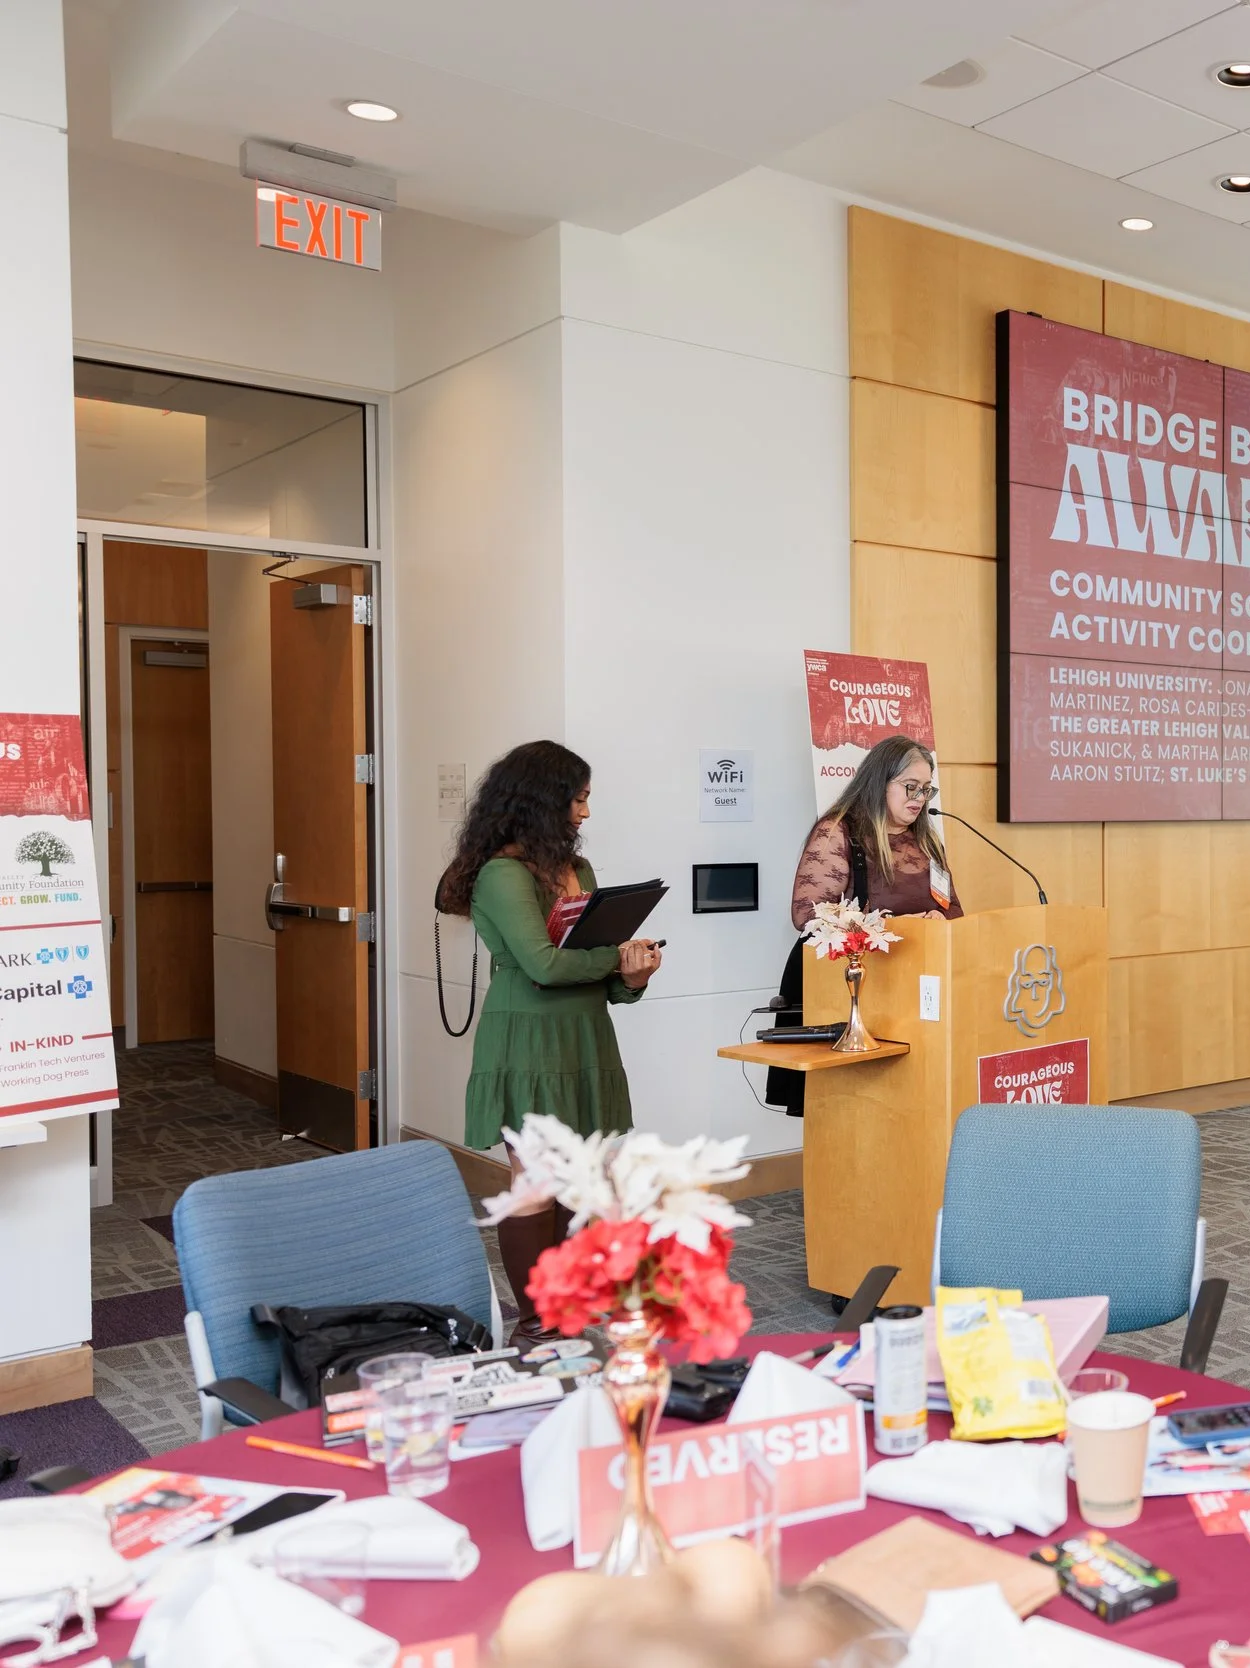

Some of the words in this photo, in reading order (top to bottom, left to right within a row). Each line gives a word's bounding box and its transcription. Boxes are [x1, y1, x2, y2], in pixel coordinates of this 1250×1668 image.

[275, 192, 370, 265] EXIT
[1063, 386, 1217, 459] BRIDGE
[1049, 570, 1222, 614] COMMUNITY
[1049, 611, 1180, 650] ACTIVITY
[829, 679, 911, 698] COURAGEOUS
[1050, 667, 1110, 687] LEHIGH
[1116, 672, 1213, 694] UNIVERSITY:
[844, 696, 901, 727] LOVE
[1050, 692, 1134, 714] MARTINEZ,
[1139, 698, 1180, 714] ROSA
[1050, 716, 1082, 733] THE
[1087, 717, 1160, 736] GREATER
[1164, 721, 1218, 738] LEHIGH
[1050, 740, 1136, 761] SUKANICK,
[1141, 744, 1152, 759] &
[1158, 744, 1218, 760] MARTHA
[708, 770, 743, 783] WiFi
[1050, 765, 1108, 781] AARON
[1114, 765, 1164, 784] STUTZ;
[1170, 767, 1193, 782] ST.
[1198, 767, 1247, 783] LUKE'S
[714, 797, 737, 805] Guest
[29, 877, 84, 889] Foundation
[20, 894, 51, 905] GROW.
[55, 892, 82, 903] FUND.
[10, 1034, 74, 1053] IN-KIND
[40, 1057, 62, 1067] Tech
[64, 1052, 105, 1063] Ventures
[1, 1075, 41, 1088] Working
[43, 1072, 63, 1082] Dog
[65, 1068, 89, 1078] Press
[994, 1061, 1075, 1089] COURAGEOUS
